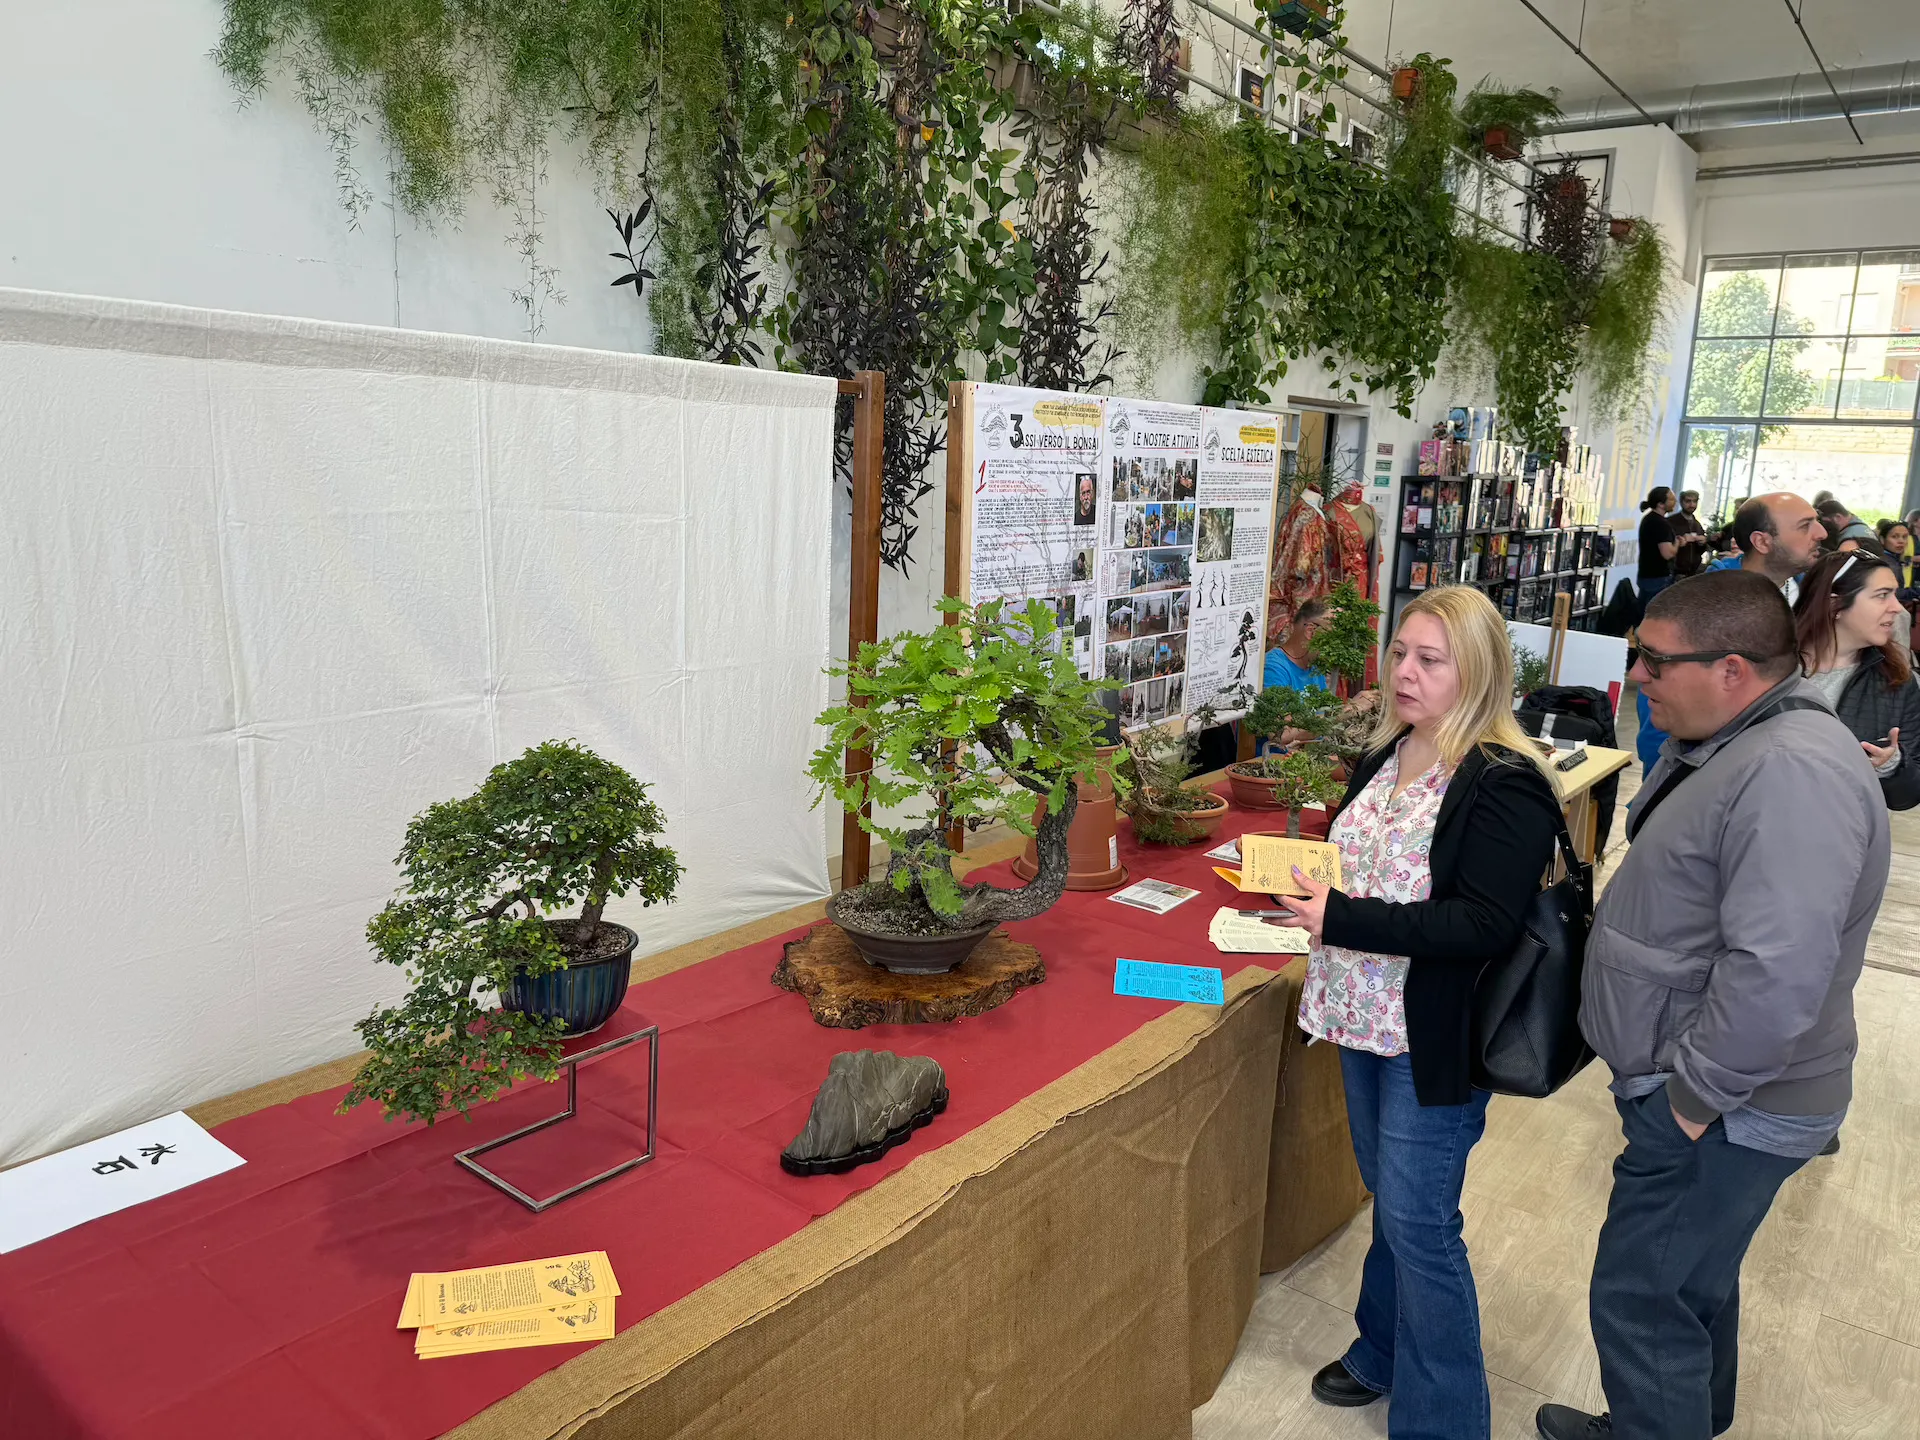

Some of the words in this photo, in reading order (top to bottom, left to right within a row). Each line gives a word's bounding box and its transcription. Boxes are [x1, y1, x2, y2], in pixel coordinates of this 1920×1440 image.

[1009, 413, 1024, 449] 3
[1133, 431, 1142, 446] LE
[1143, 432, 1170, 447] NOSTRE
[1171, 432, 1200, 449] ATTIVITÀ
[1014, 433, 1036, 447] PASSI
[1038, 434, 1063, 448] VERSO
[1065, 435, 1071, 449] IL
[1073, 436, 1099, 450] BONSAI
[1221, 447, 1245, 462] SCELTA
[1247, 448, 1274, 463] ESTETICA
[975, 459, 987, 494] 1
